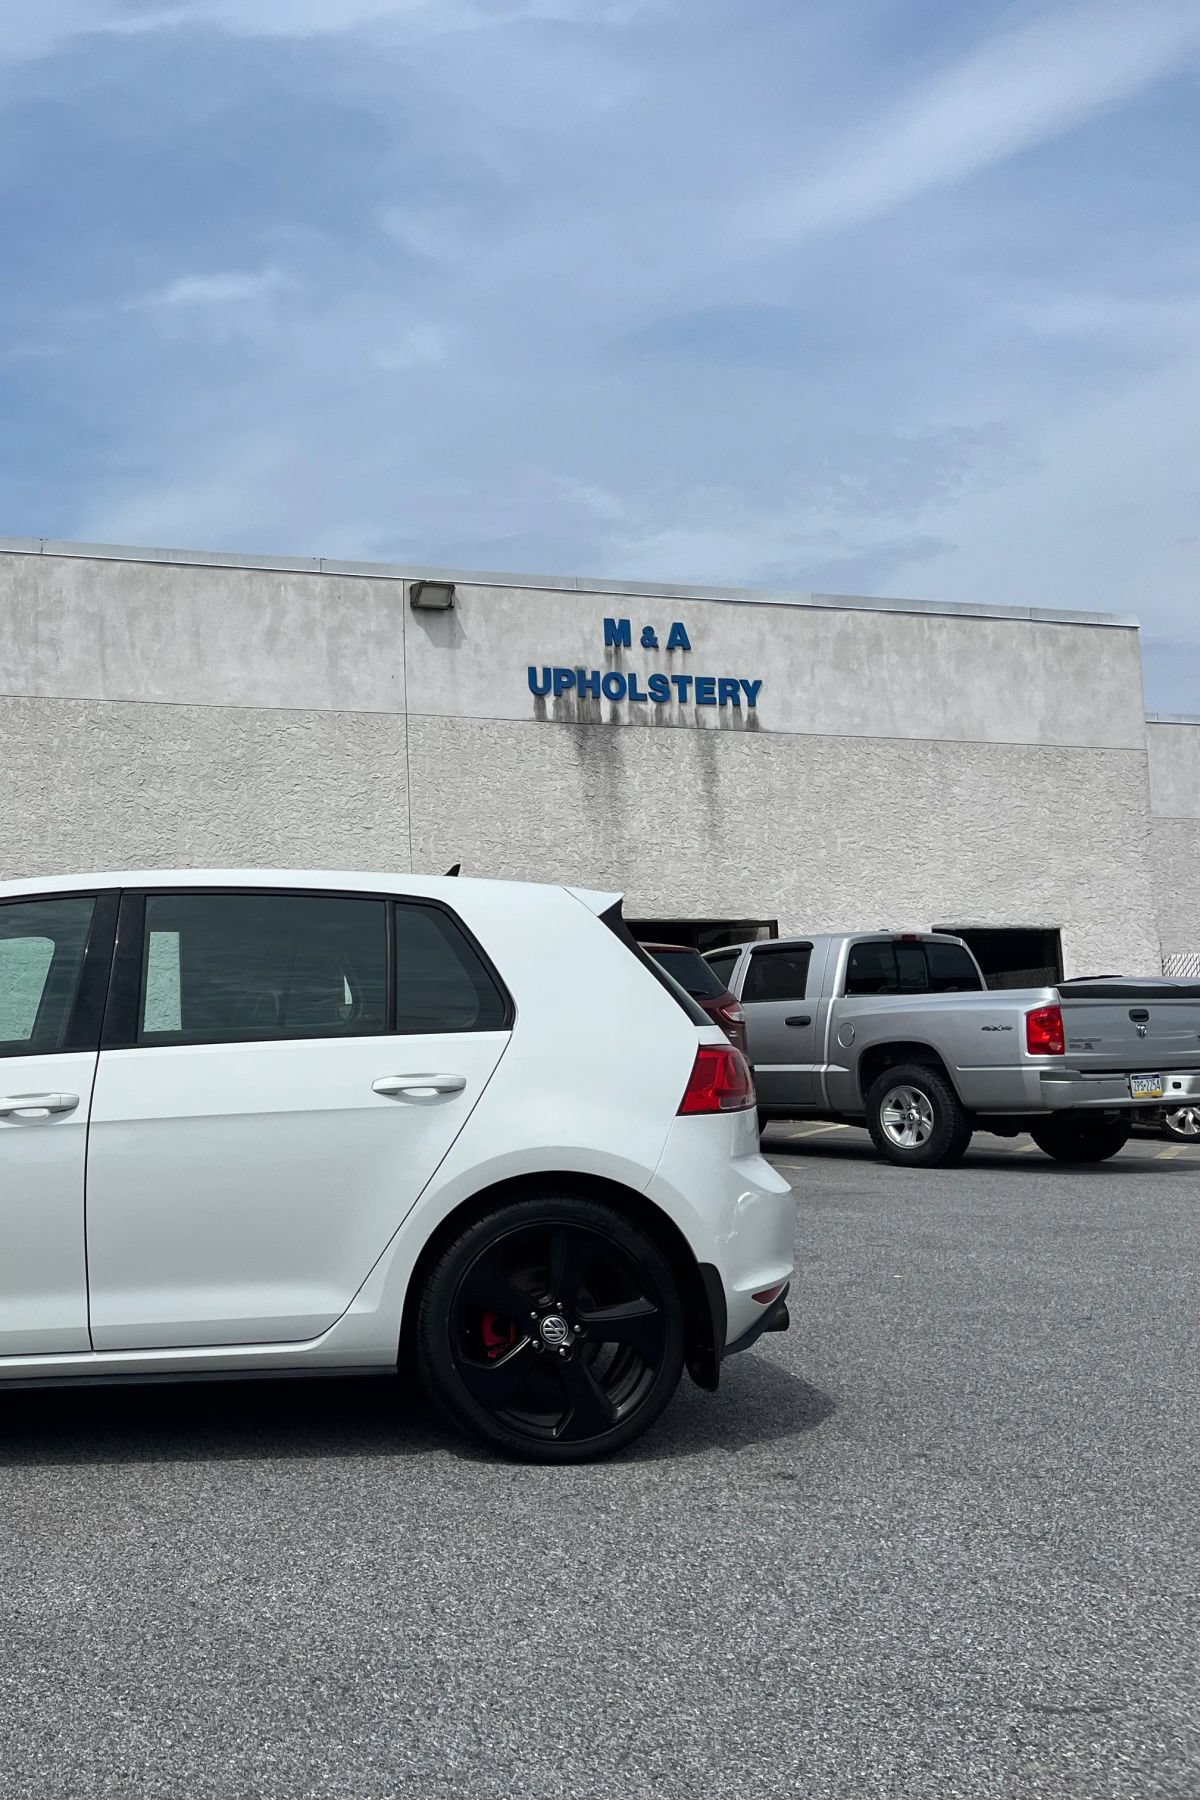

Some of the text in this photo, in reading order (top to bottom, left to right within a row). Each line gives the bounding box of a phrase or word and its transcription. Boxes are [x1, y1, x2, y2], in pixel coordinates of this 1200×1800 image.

[603, 618, 691, 650] M & A
[527, 666, 762, 707] UPHOLSTERY
